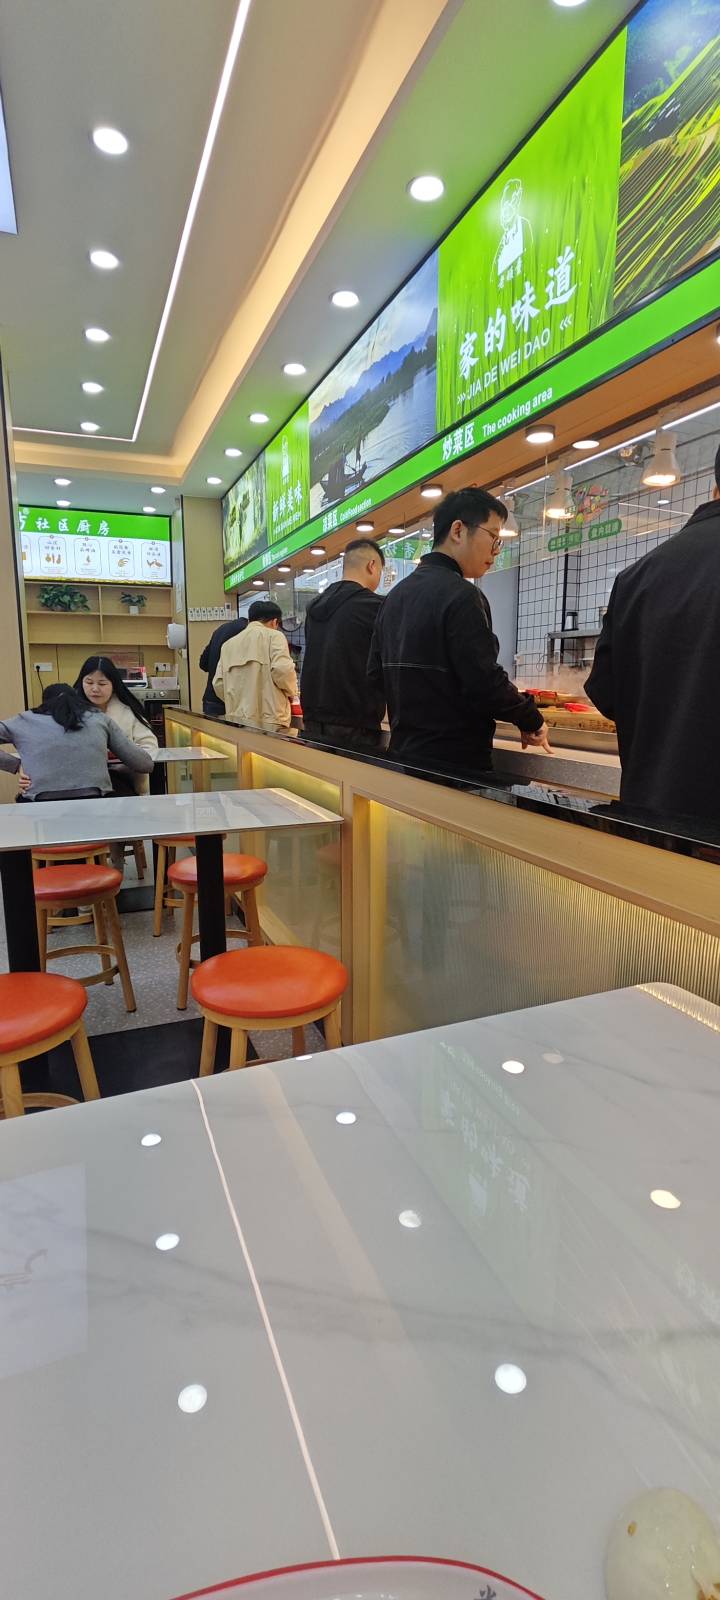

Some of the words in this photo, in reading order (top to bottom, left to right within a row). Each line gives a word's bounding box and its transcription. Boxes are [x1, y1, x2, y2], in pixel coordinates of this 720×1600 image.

[458, 246, 577, 380] 家的味道
[467, 380, 482, 400] JIA
[484, 366, 498, 386] DE
[500, 350, 521, 375] WEI
[524, 328, 551, 358] DAO
[442, 422, 475, 461] 炒菜区
[482, 420, 496, 437] The
[497, 402, 531, 430] cooking
[532, 386, 553, 410] area
